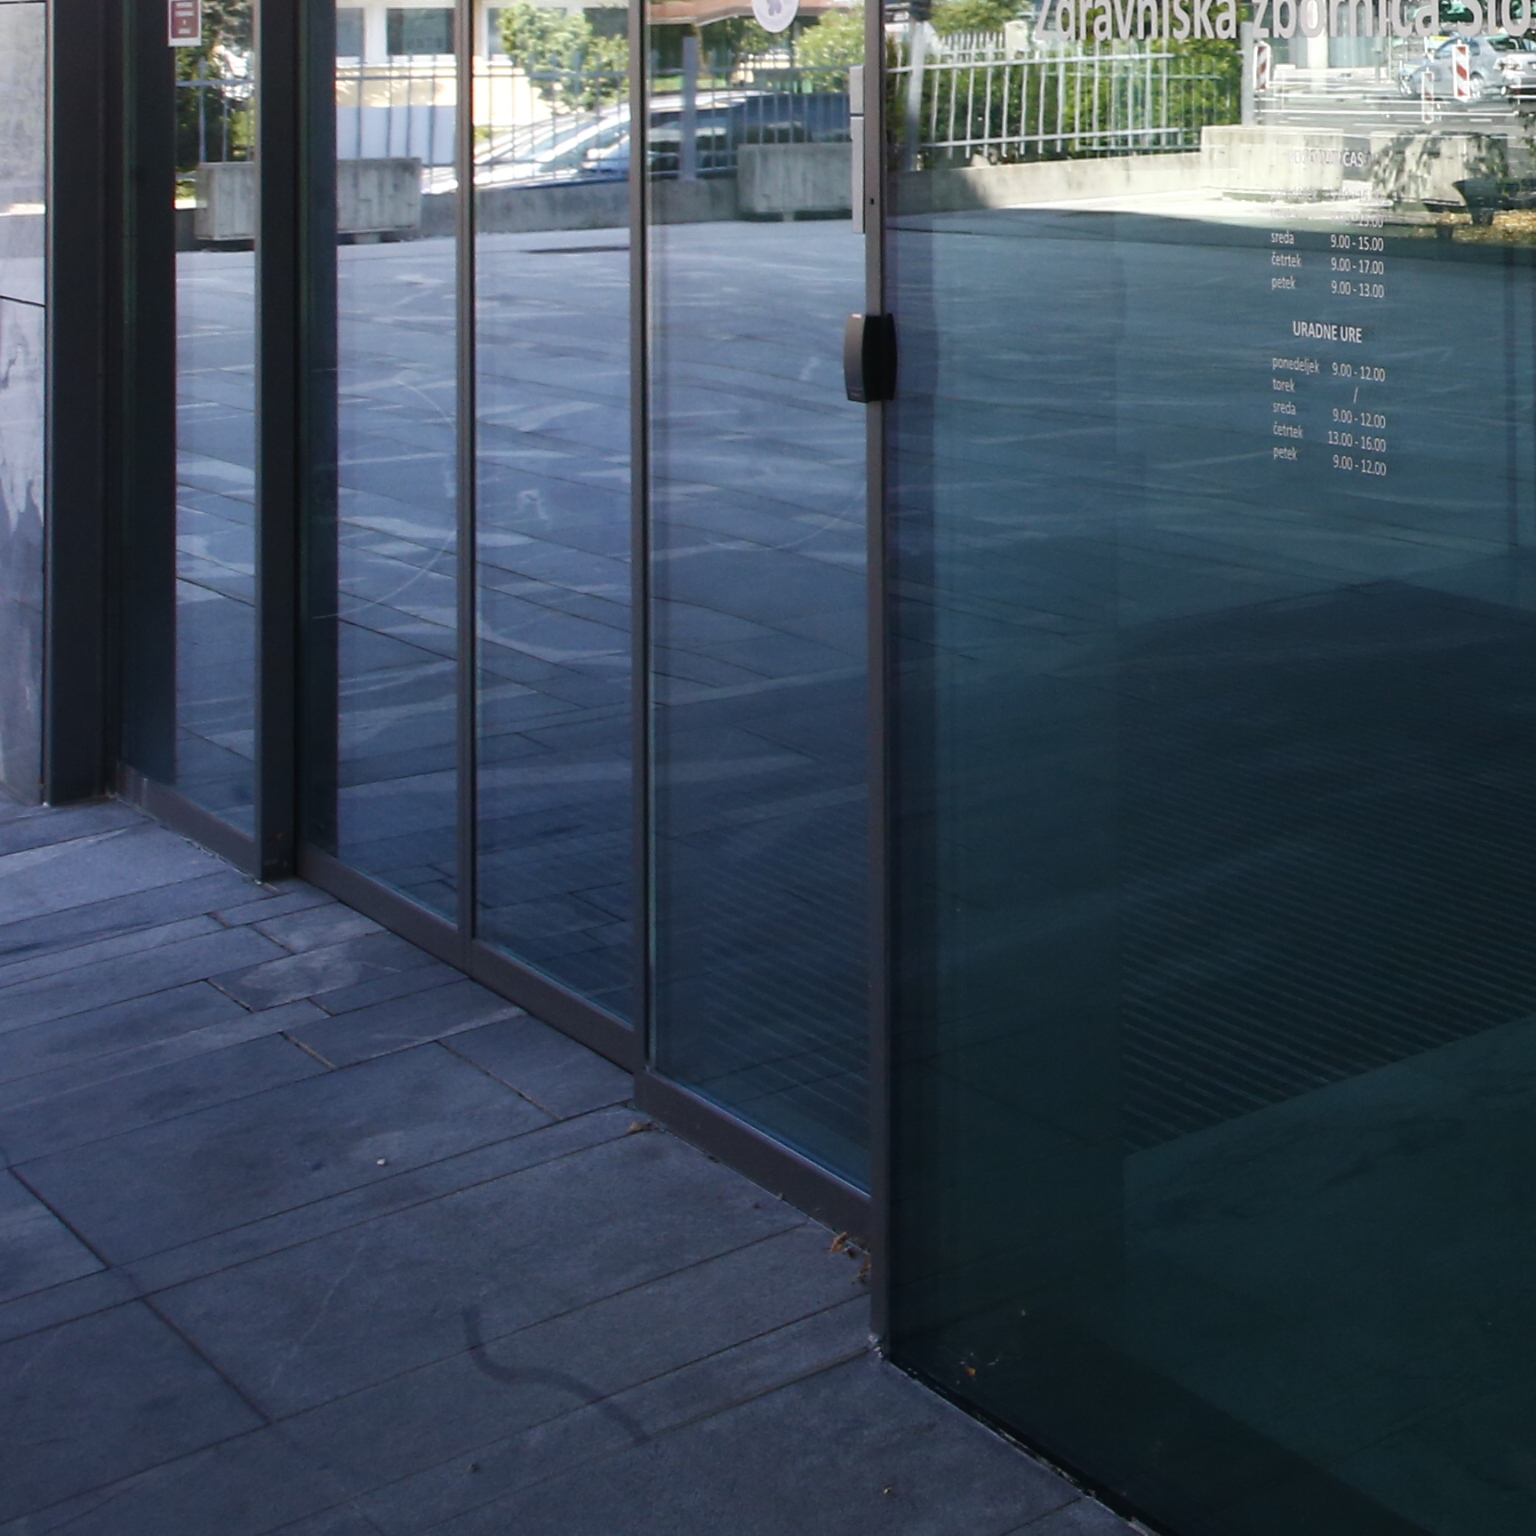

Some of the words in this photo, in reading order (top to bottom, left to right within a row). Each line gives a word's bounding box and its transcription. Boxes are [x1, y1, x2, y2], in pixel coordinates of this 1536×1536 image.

[1343, 148, 1364, 167] ČAS
[1271, 230, 1295, 245] sreda
[1330, 234, 1350, 249] 9.00
[1358, 236, 1384, 252] 15.00
[1331, 257, 1351, 272] 9.00
[1359, 259, 1384, 275] 17.00
[1271, 276, 1296, 290] petek
[1331, 280, 1351, 295] 9.00
[1359, 282, 1385, 298] 13.00
[1293, 320, 1338, 341] URADNE
[1340, 326, 1362, 343] URE
[1272, 357, 1320, 375] ponedeljek
[1332, 362, 1352, 377] 9.00
[1360, 366, 1386, 382] 12.00
[1272, 378, 1295, 393] torek
[1272, 401, 1296, 415] sreda
[1332, 408, 1352, 424] 9.00
[1360, 412, 1386, 429] 12.00
[1328, 430, 1353, 447] 13.00
[1361, 436, 1386, 452] 16.00
[1273, 446, 1298, 461] petek
[1333, 454, 1353, 470] 9.00
[1361, 459, 1387, 476] 12.00
